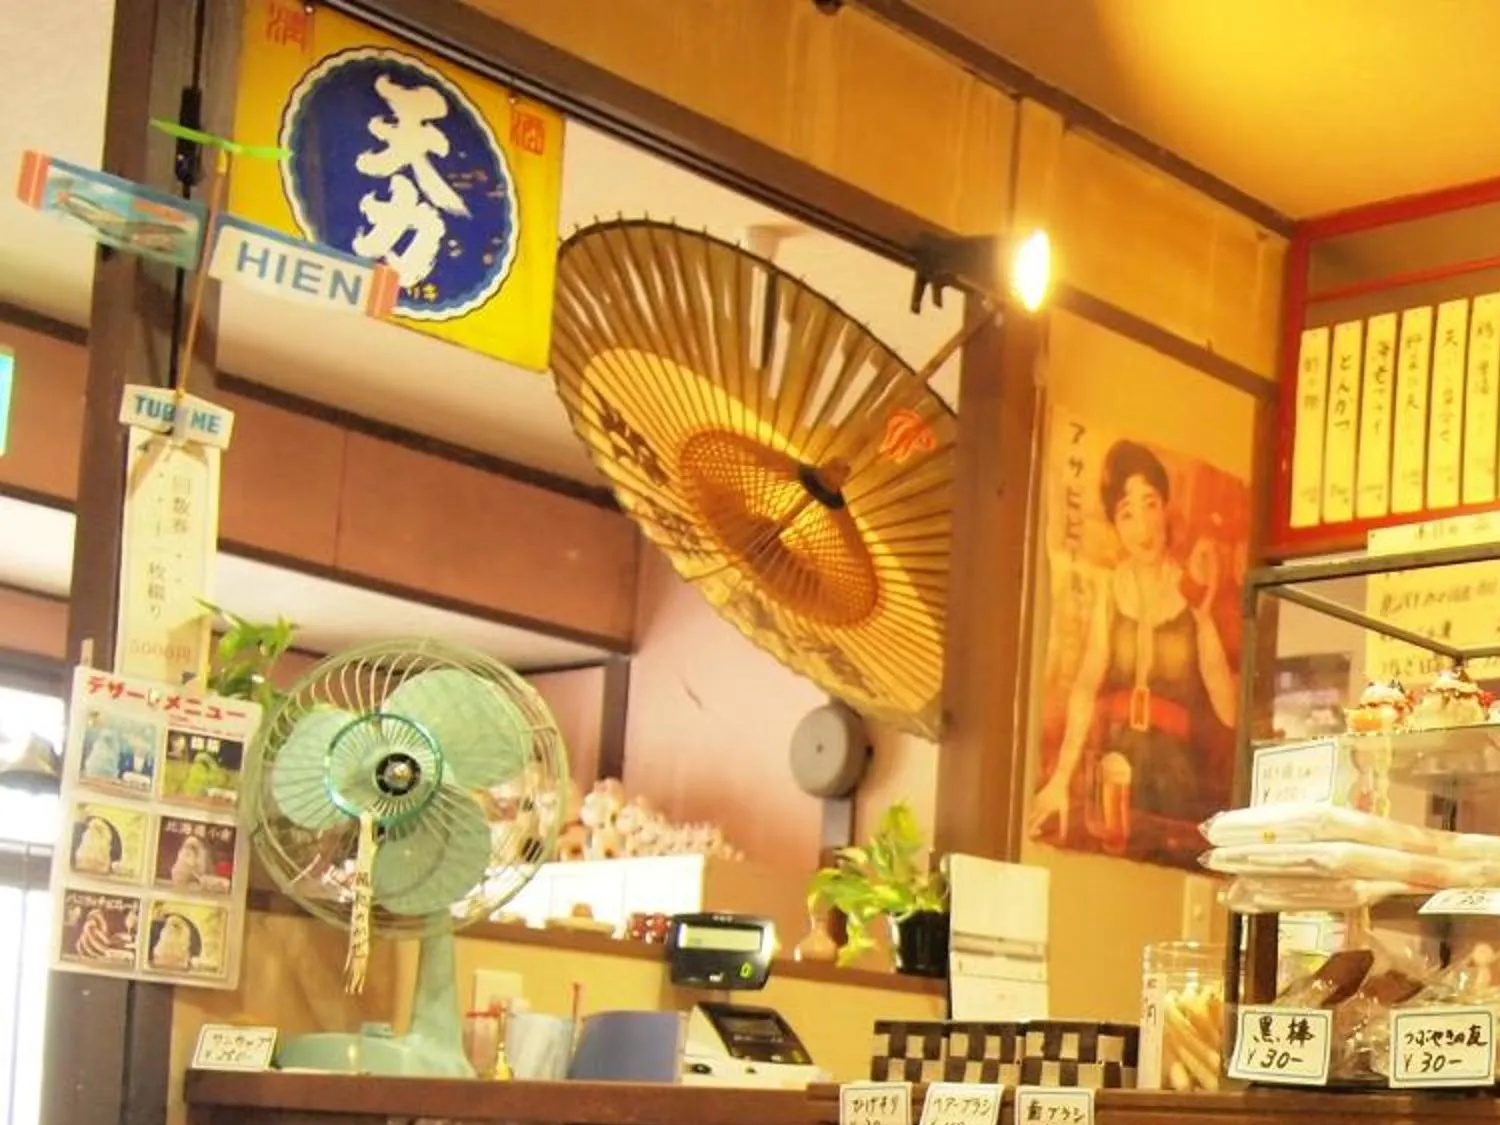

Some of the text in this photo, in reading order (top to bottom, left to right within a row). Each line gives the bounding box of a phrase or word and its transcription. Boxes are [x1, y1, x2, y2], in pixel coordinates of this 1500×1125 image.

[236, 240, 364, 306] HIEN
[134, 395, 221, 434] TUBME
[87, 676, 246, 720] デザーメニュー
[1253, 1016, 1315, 1045] 黒棒
[1026, 1099, 1085, 1123] 歯ブラシ
